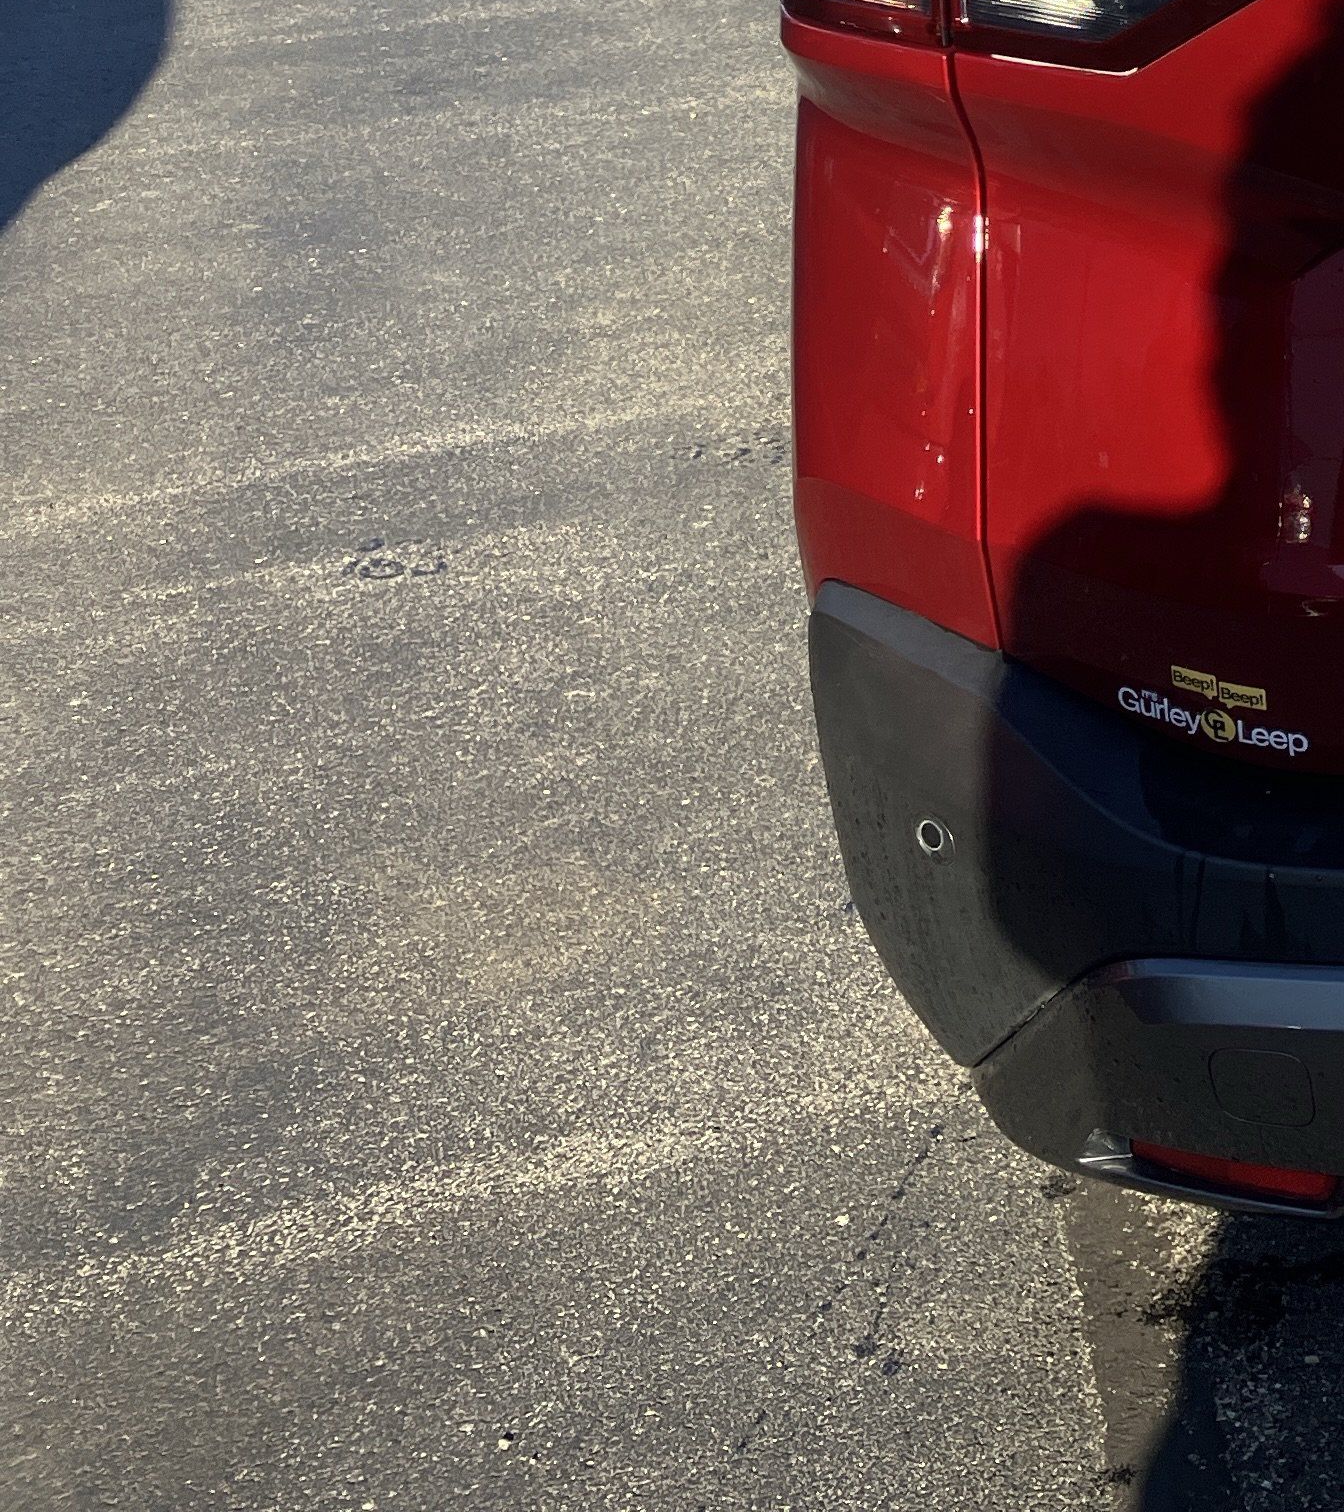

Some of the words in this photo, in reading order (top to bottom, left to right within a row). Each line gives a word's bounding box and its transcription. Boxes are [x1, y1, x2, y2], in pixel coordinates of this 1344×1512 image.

[1173, 669, 1215, 692] Beep!
[1221, 687, 1264, 707] Beep!
[1117, 686, 1200, 735] Gurley
[1237, 719, 1309, 757] Leep
